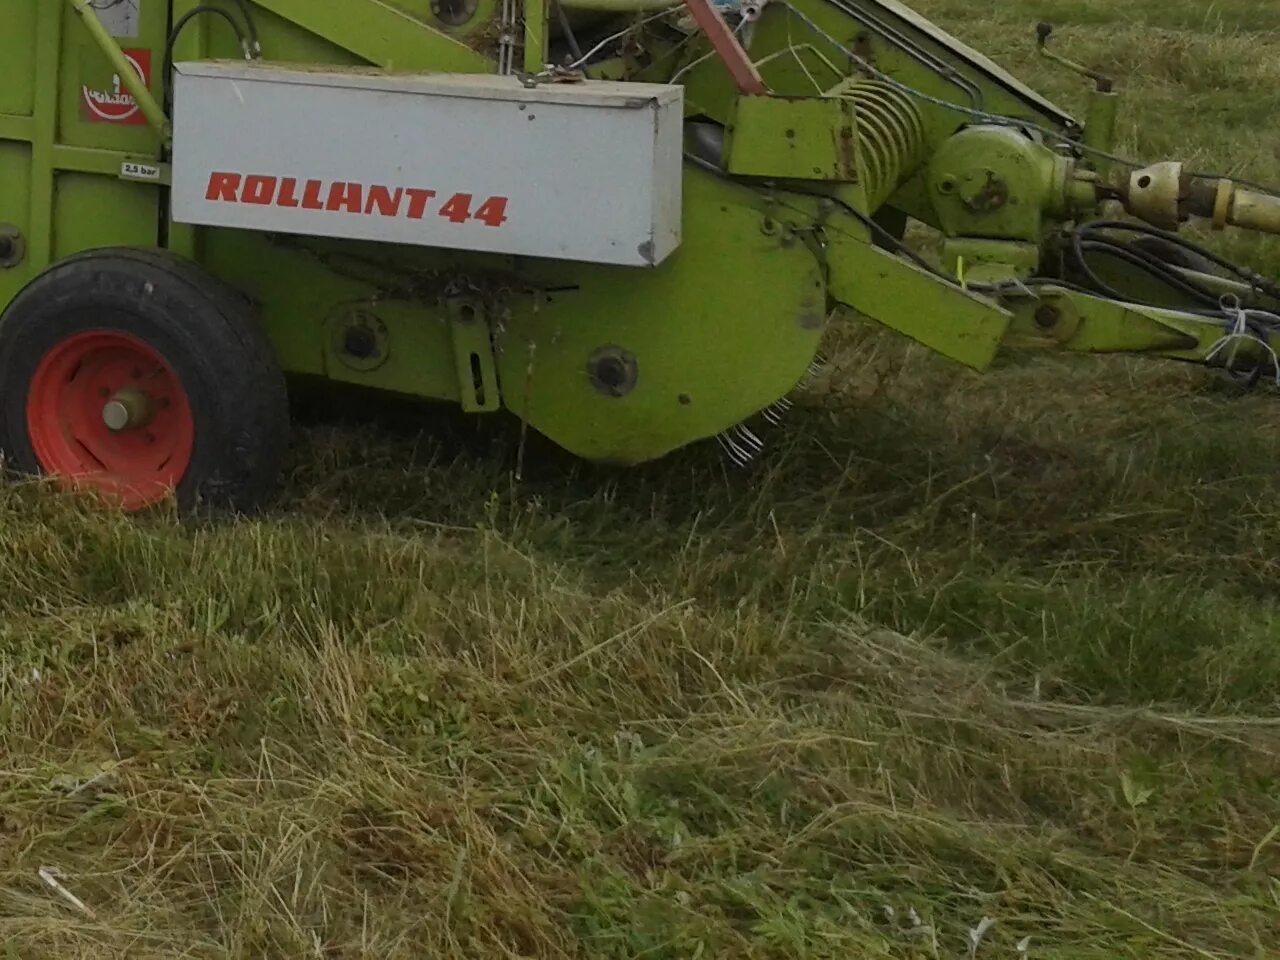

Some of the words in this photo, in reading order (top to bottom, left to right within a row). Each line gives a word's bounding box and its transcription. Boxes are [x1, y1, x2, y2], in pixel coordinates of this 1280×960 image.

[140, 166, 156, 175] bar
[205, 171, 436, 219] ROLLANT
[438, 192, 508, 227] 44
